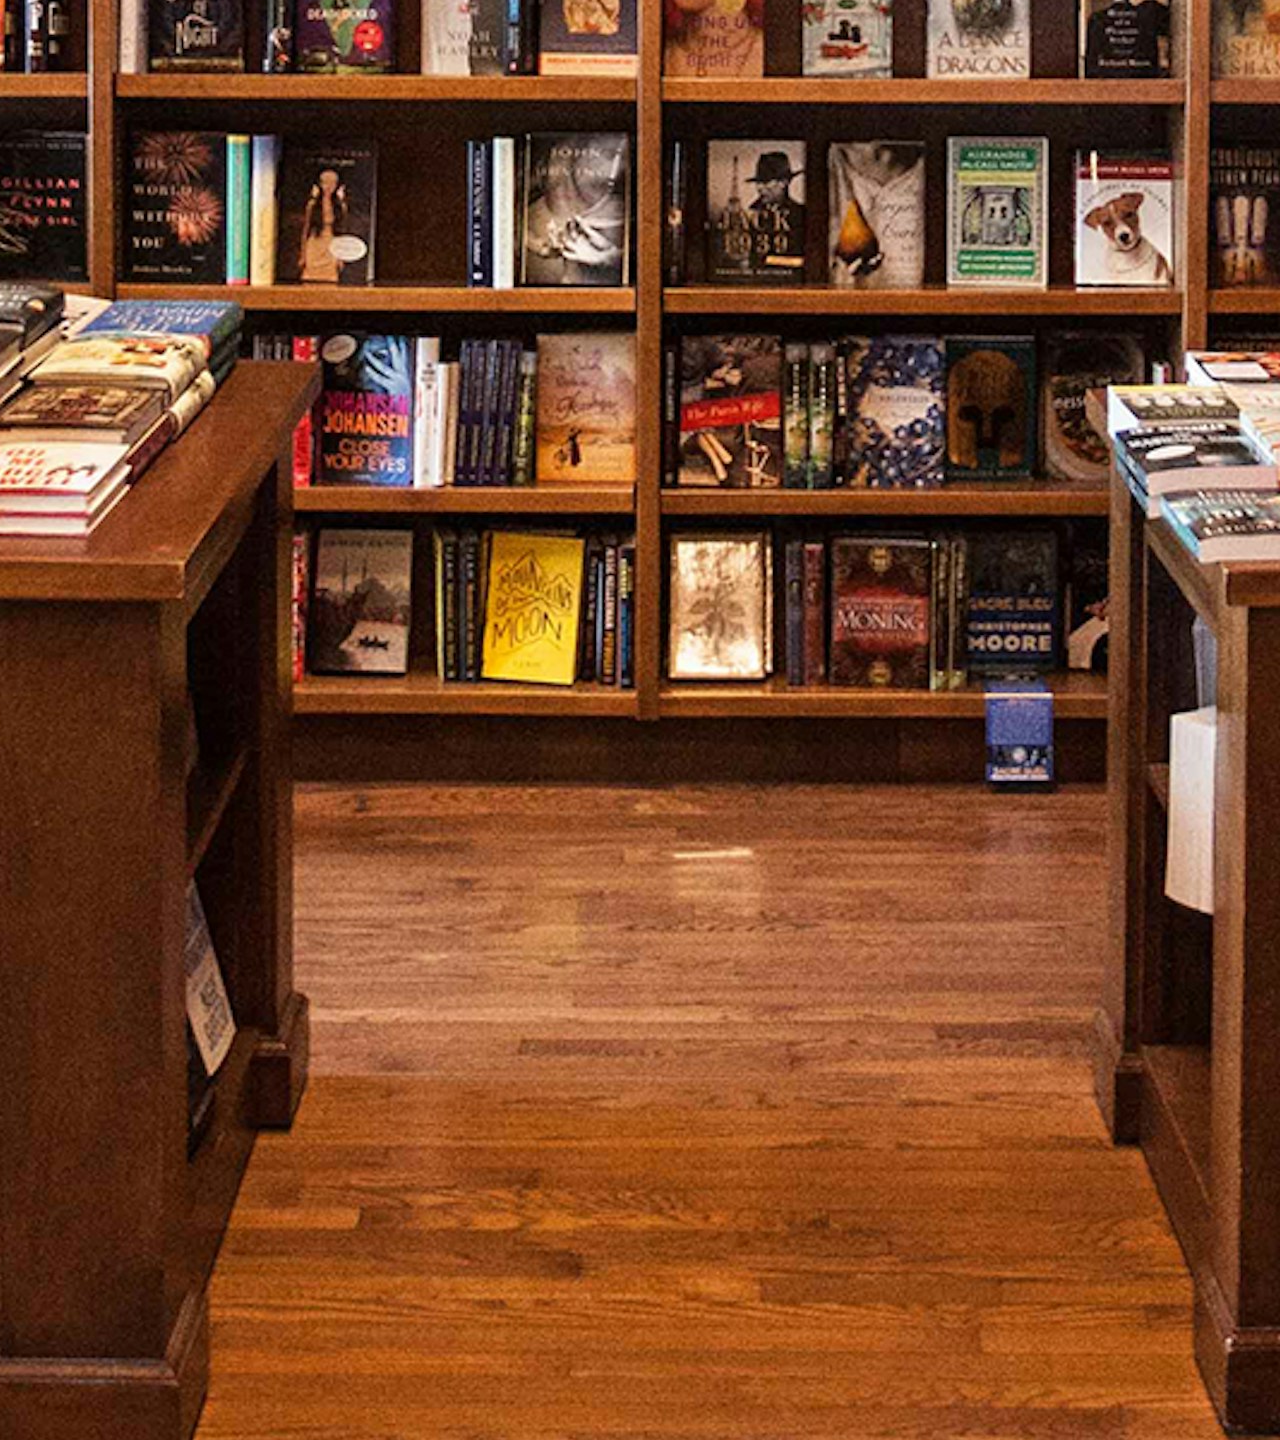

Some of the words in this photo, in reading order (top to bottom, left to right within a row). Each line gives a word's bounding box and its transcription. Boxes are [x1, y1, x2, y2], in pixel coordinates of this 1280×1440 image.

[936, 56, 1024, 74] DRAGONS
[550, 147, 603, 161] JOHN
[132, 158, 166, 171] THE
[1, 175, 80, 190] GILLIAN
[10, 195, 72, 208] FLYNN
[720, 210, 792, 232] JACK
[132, 237, 164, 249] YOU
[721, 235, 790, 254] 1939
[323, 413, 409, 437] JOHANSEN
[338, 438, 391, 457] CLOSE
[325, 455, 363, 472] YOUR
[369, 456, 406, 472] EYES
[491, 609, 564, 648] MOON
[838, 610, 925, 631] MONING
[968, 634, 1052, 652] MOORE
